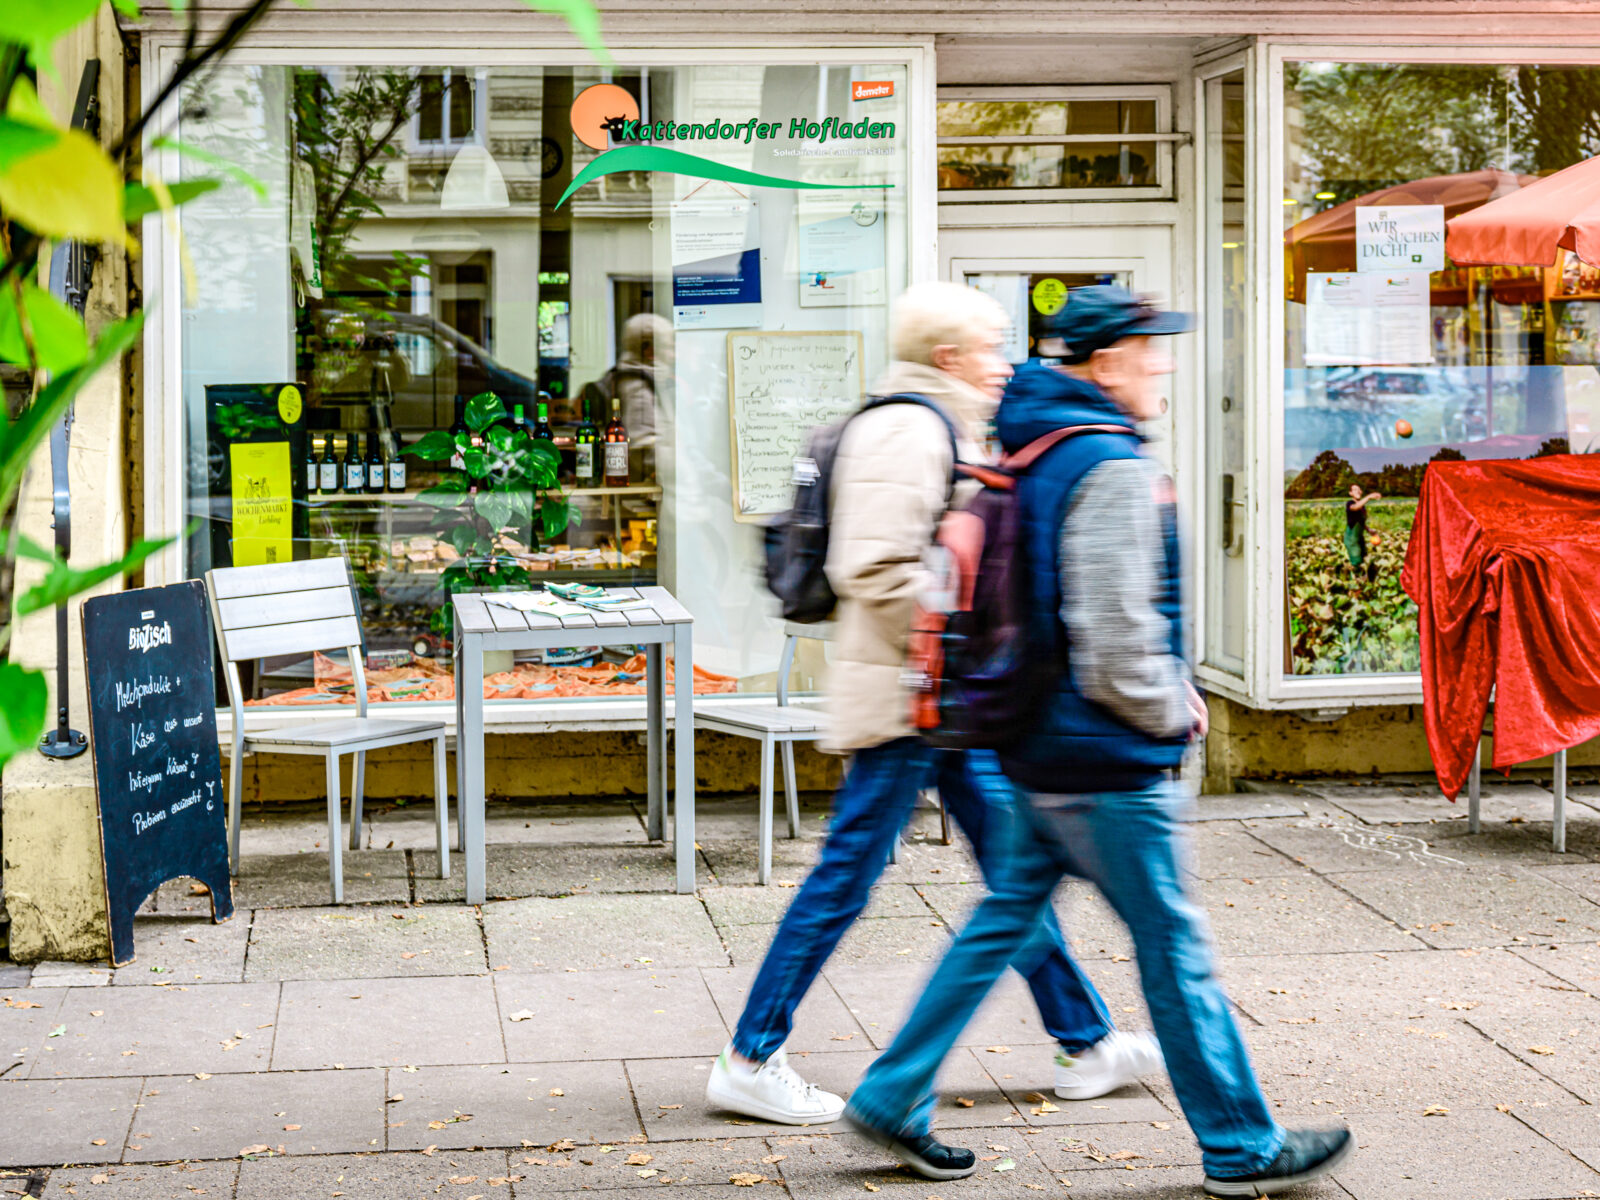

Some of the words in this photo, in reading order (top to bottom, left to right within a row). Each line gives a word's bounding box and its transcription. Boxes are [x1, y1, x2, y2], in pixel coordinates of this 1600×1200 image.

[855, 86, 890, 98] demeter
[621, 118, 782, 144] Kattendorfer
[788, 116, 896, 143] Hofladen
[1368, 220, 1398, 234] WIR
[1387, 231, 1440, 245] SUCHEN
[1362, 243, 1408, 257] DICH!
[131, 722, 156, 756] Käse
[163, 718, 178, 733] aus
[132, 812, 166, 836] Probieren
